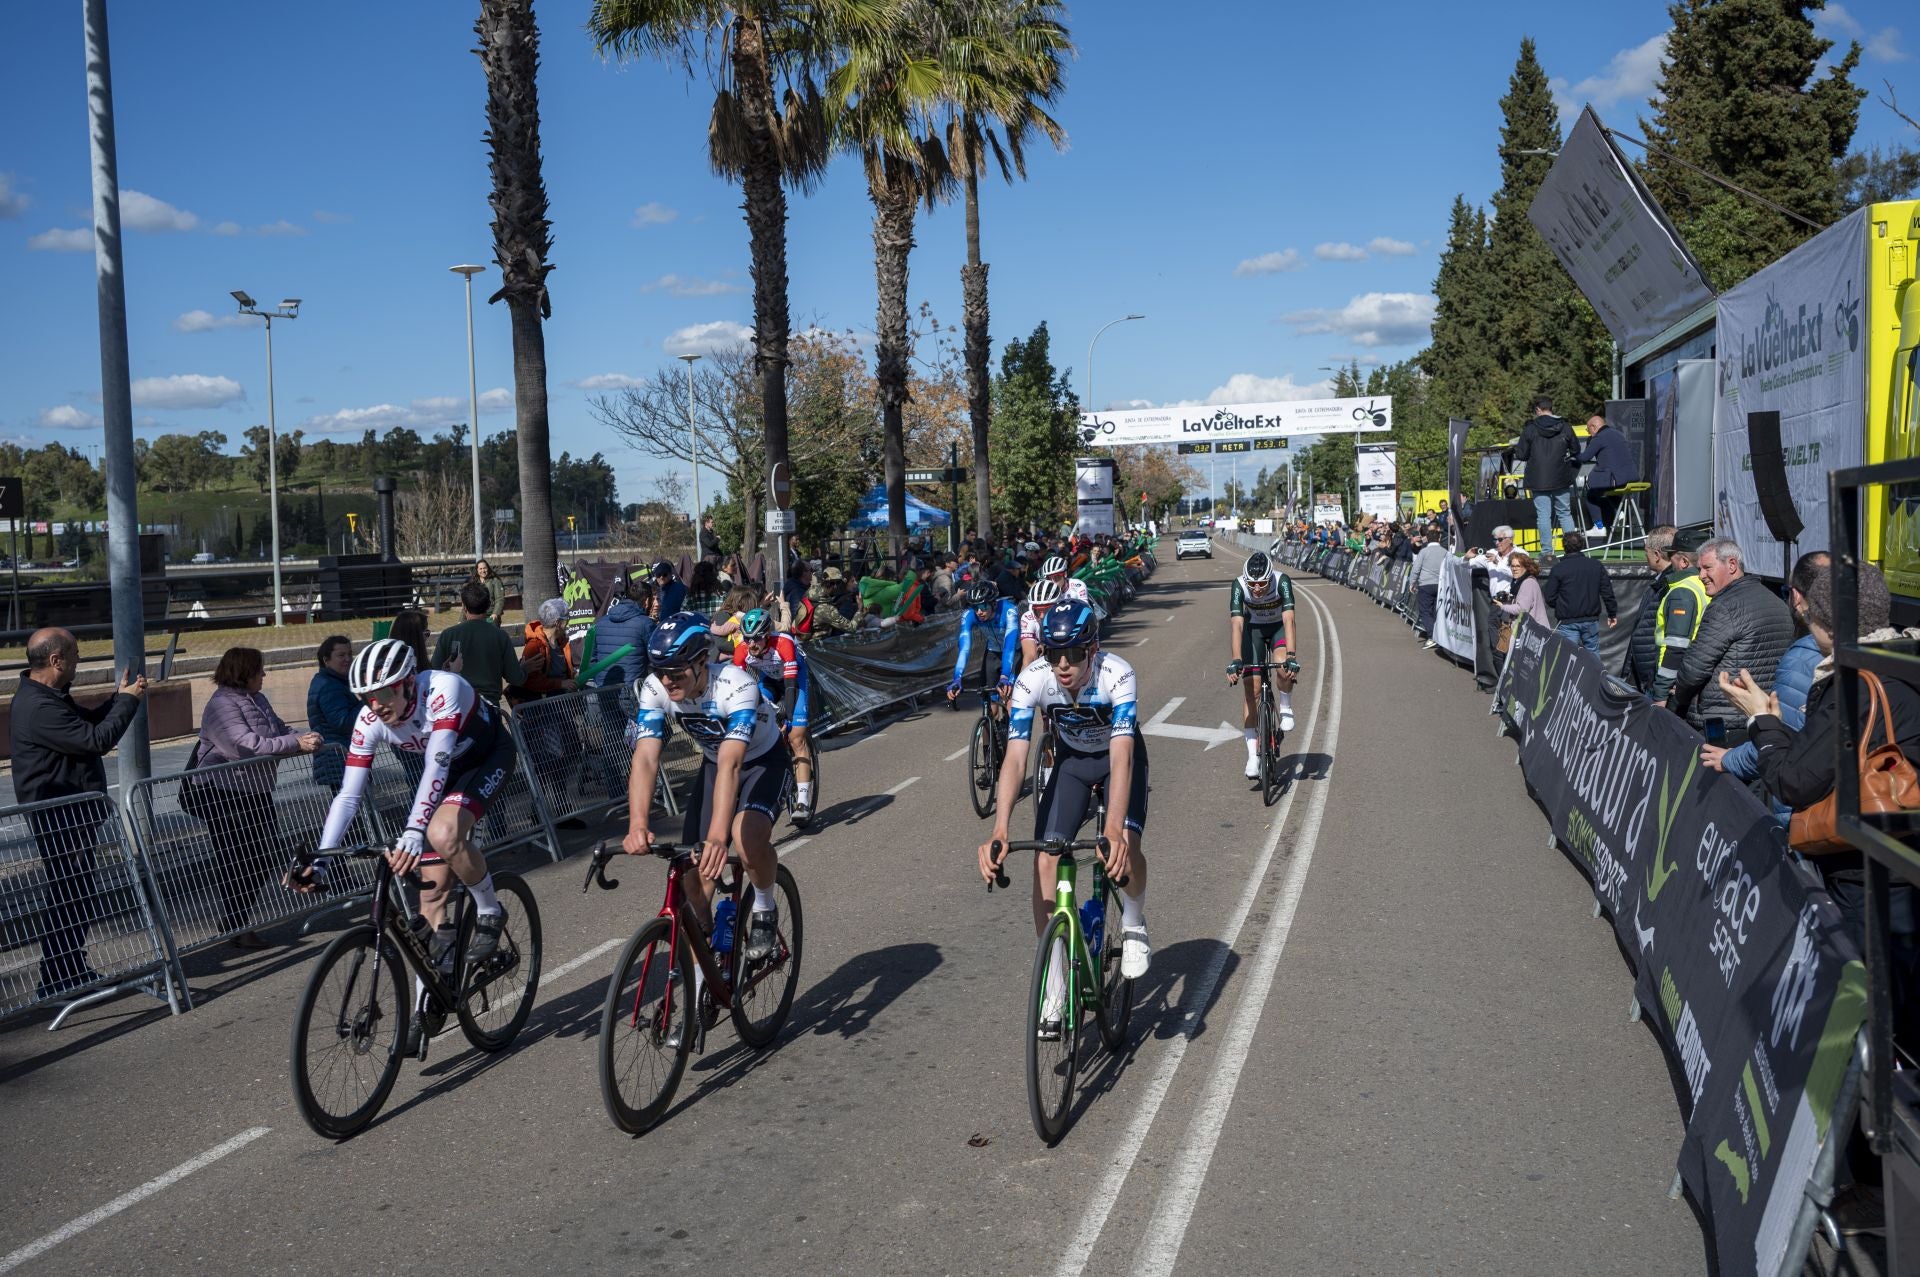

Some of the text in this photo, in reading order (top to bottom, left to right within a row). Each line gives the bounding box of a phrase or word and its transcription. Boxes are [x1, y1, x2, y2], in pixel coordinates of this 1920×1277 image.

[1741, 303, 1823, 379] LaVueltaExt
[1791, 364, 1823, 384] Extremadura
[1183, 415, 1282, 433] LaVueltaExt
[1314, 406, 1343, 414] EXTREMADURA
[1222, 443, 1244, 452] META
[1544, 654, 1657, 860] Extremadura
[478, 768, 506, 798] telco.
[416, 777, 445, 826] telco.
[1709, 918, 1740, 988] SPORT
